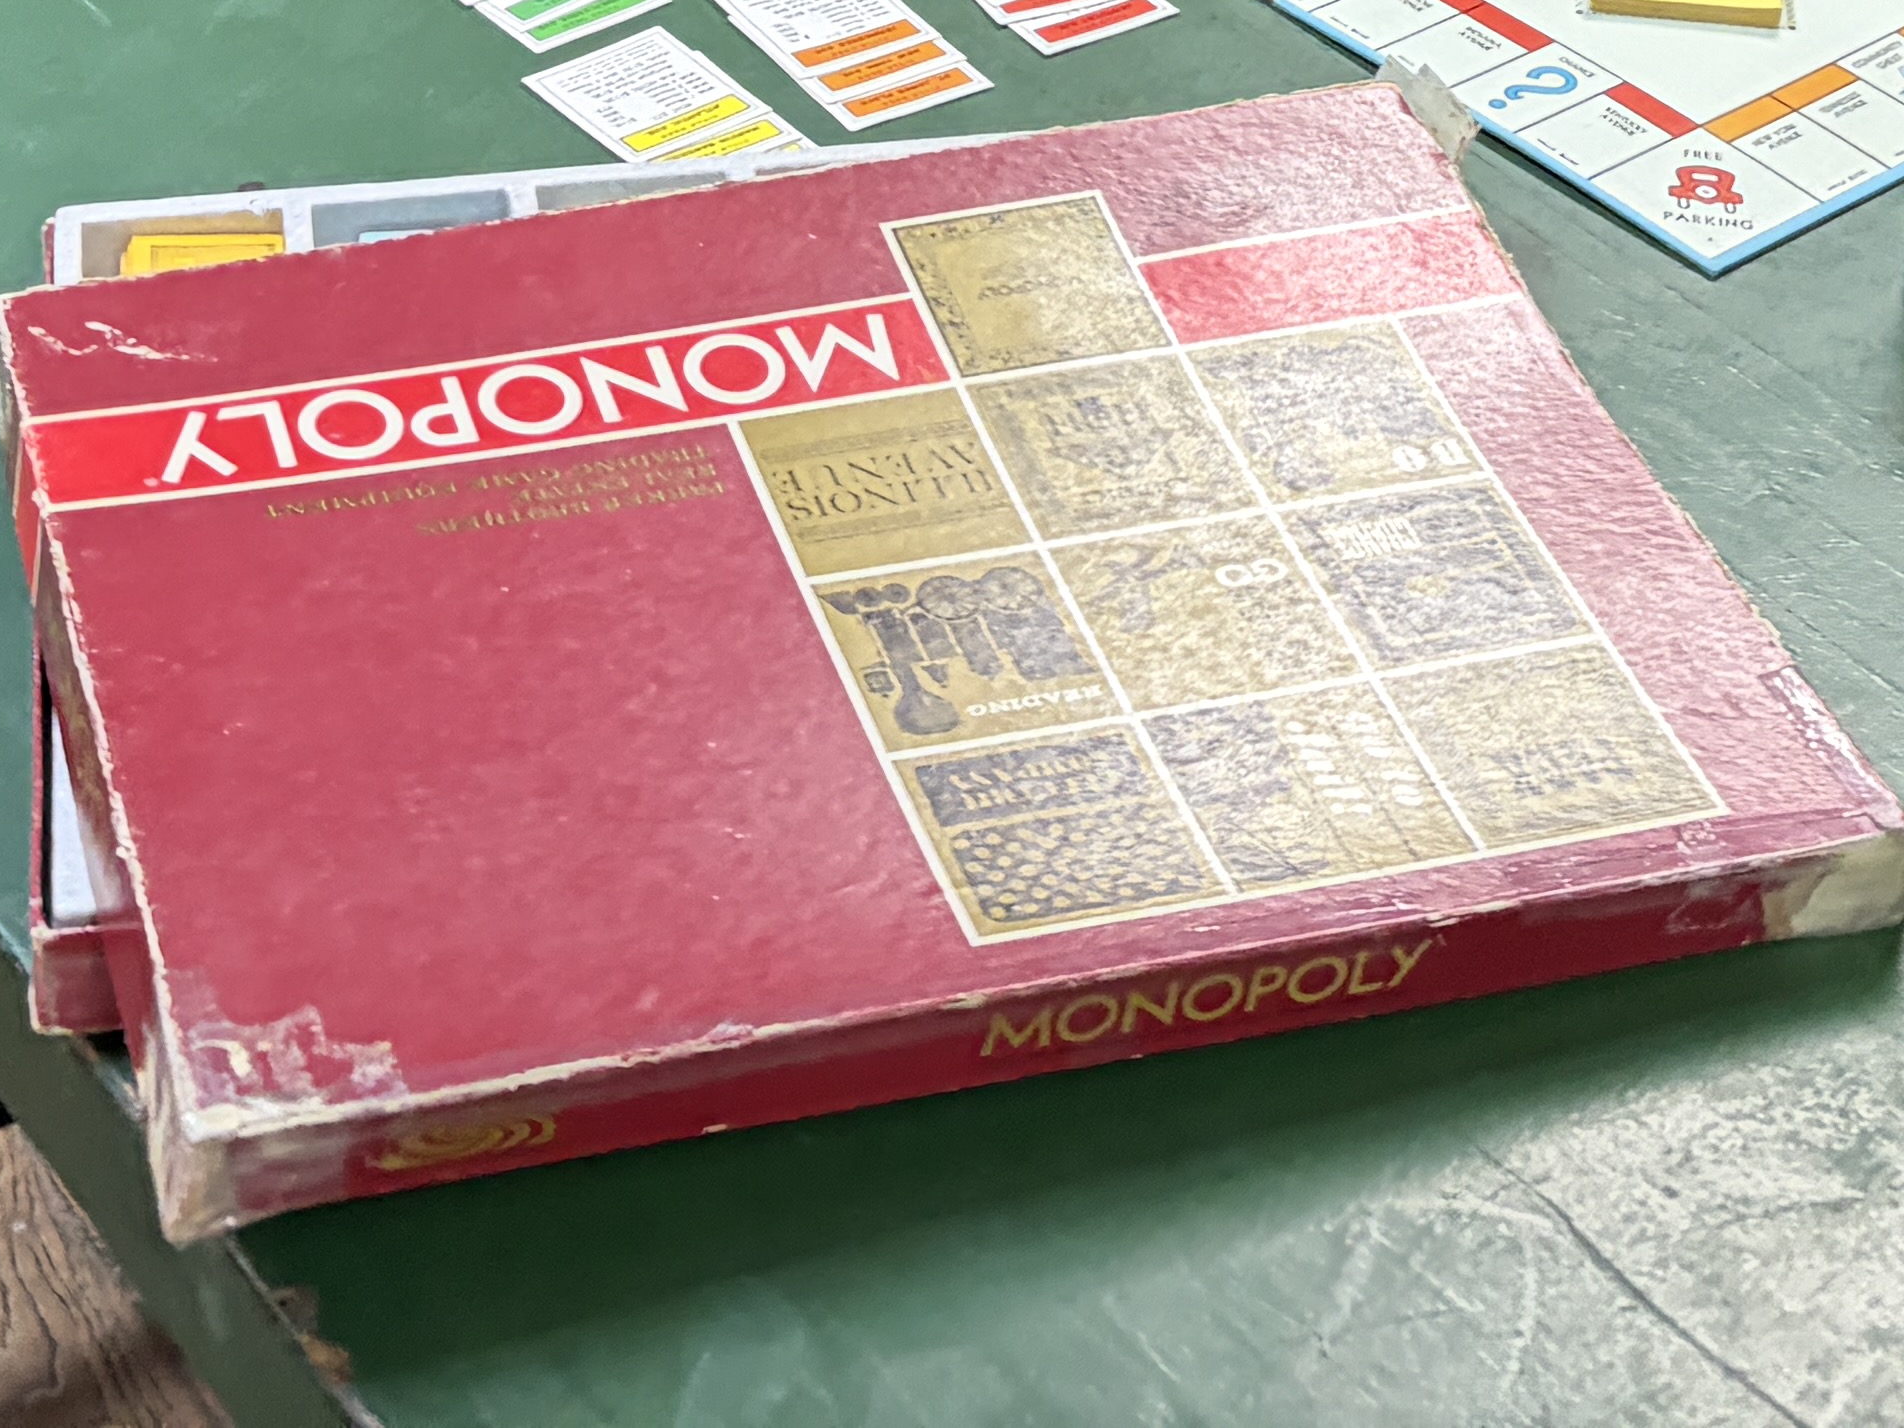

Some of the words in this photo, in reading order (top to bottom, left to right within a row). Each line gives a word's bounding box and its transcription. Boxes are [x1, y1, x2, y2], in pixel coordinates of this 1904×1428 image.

[1682, 148, 1724, 162] FREE
[1662, 210, 1755, 231] PARKING
[159, 311, 900, 483] MONOPOLY
[580, 445, 707, 477] TRADING
[643, 463, 718, 488] REAL
[770, 441, 976, 494] AVENUE
[468, 467, 561, 492] GAME
[511, 475, 630, 505] ESTATE
[785, 469, 992, 522] ILLINOIS
[264, 481, 457, 520] EQUIPMENT
[602, 481, 725, 512] PARKER
[415, 499, 590, 536] BROTHERS
[1215, 555, 1289, 588] GO
[964, 683, 1105, 720] READING
[979, 934, 1430, 1060] MONOPOLY
